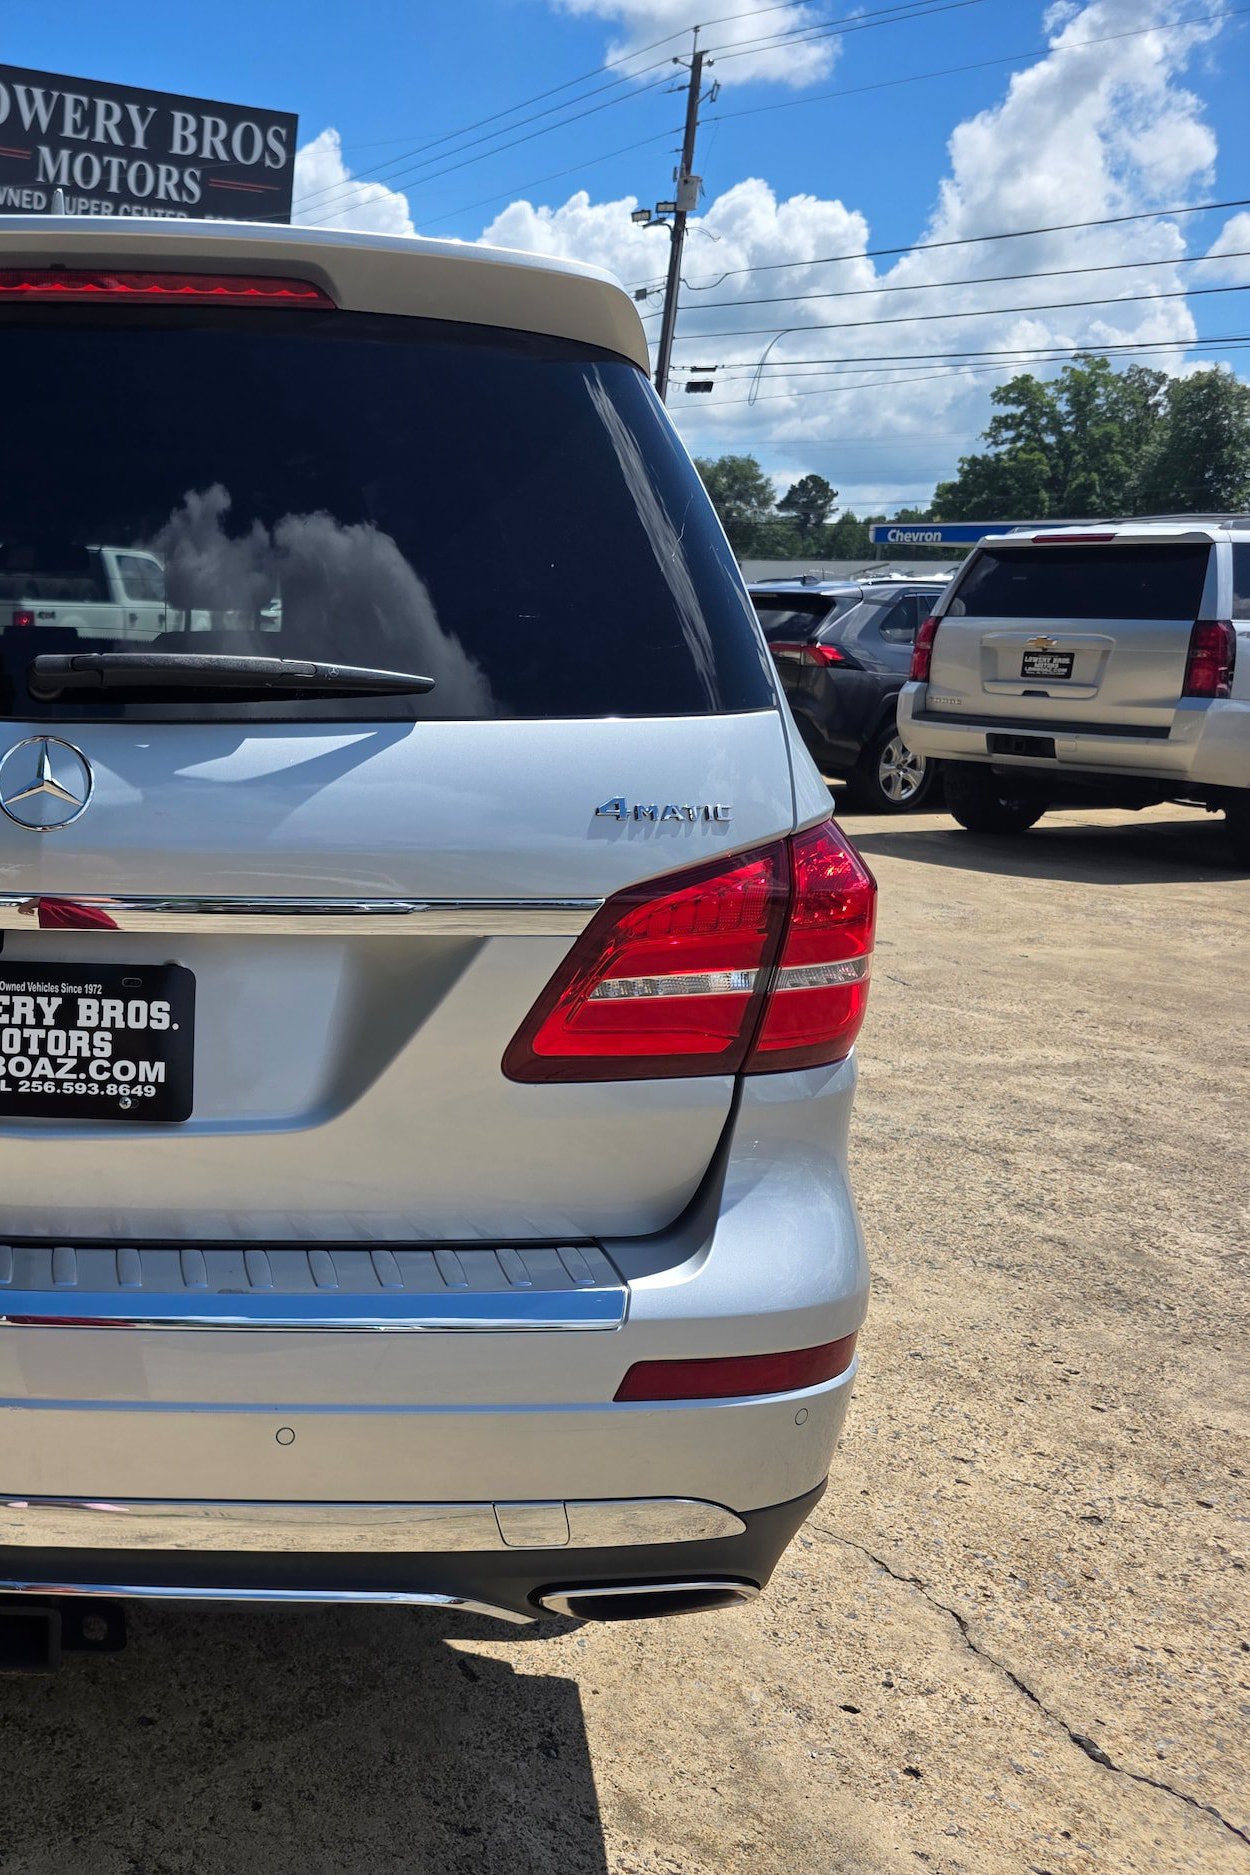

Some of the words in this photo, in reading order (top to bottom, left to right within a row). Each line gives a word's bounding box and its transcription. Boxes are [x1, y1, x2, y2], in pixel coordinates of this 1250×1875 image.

[169, 111, 288, 170] BROS
[36, 145, 203, 205] MOTORS
[65, 196, 114, 216] UPER
[887, 529, 942, 542] Chevron
[595, 796, 734, 822] 4MATIC
[27, 981, 60, 993] Vehicles
[60, 983, 83, 994] Since
[84, 984, 103, 995] 1972
[77, 998, 180, 1030] BROS.
[17, 1079, 157, 1097] 256.593.8649
